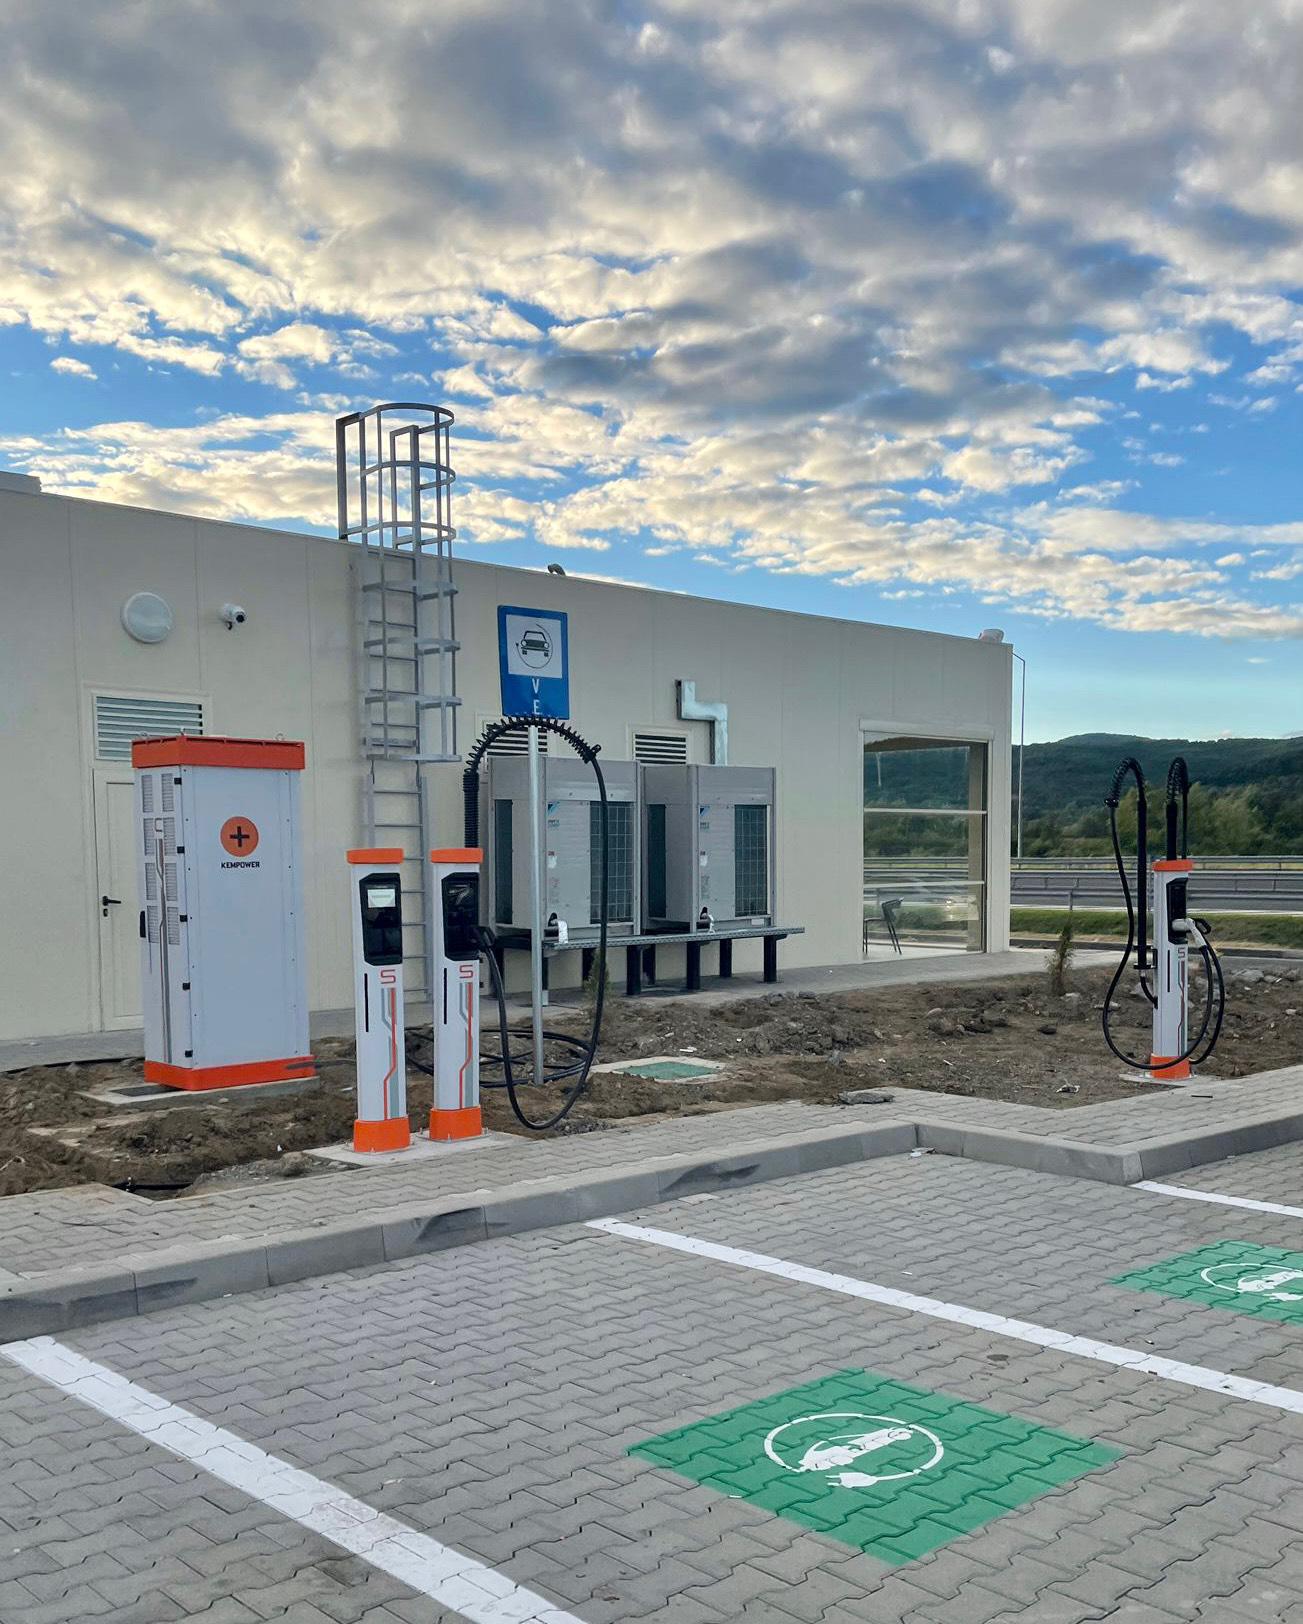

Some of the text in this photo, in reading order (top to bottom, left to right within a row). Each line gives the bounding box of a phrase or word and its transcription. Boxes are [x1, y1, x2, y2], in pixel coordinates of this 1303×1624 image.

[221, 861, 260, 869] KEMPOWER
[381, 969, 396, 984] S
[459, 965, 473, 979] S
